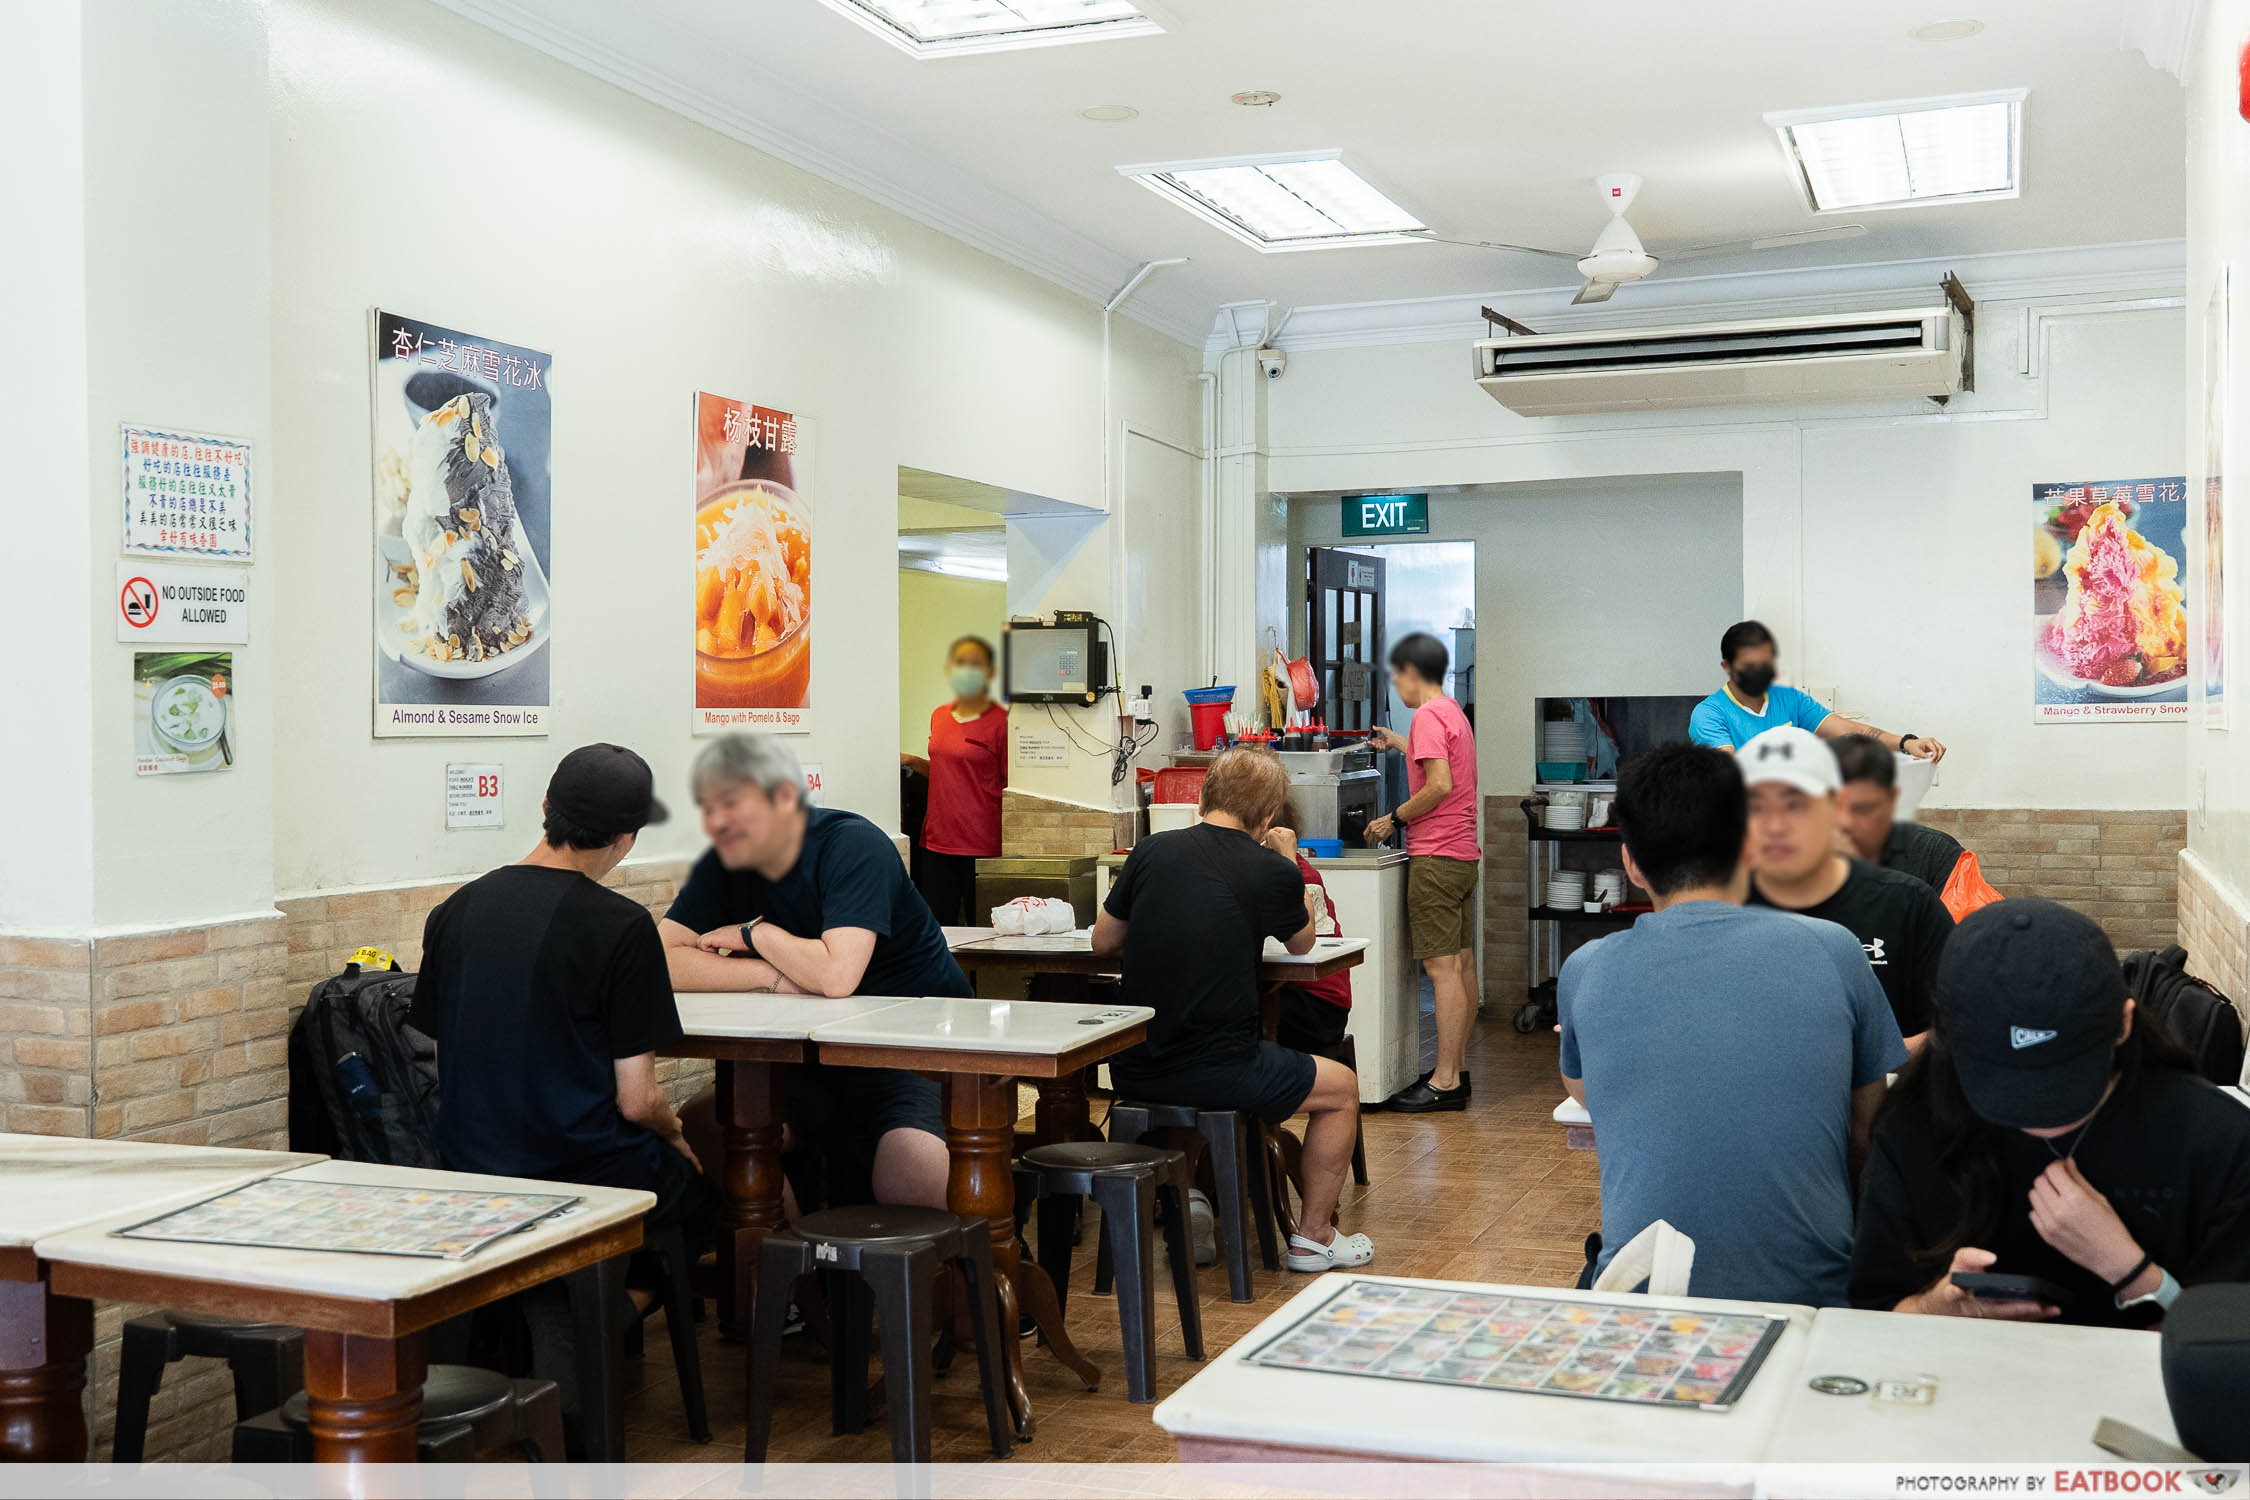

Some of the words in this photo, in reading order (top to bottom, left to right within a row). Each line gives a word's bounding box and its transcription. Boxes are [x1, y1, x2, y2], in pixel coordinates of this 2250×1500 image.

[391, 326, 543, 391] 杏仁芝麻雪花冰
[723, 406, 797, 456] 杨枝甘露
[2043, 482, 2187, 508] 芒果草莓雪花
[1362, 502, 1407, 528] EXIT
[162, 585, 176, 600] NO
[178, 586, 218, 602] OUTSIDE
[220, 588, 245, 603] FOOD
[182, 608, 227, 623] ALLOWED
[392, 709, 435, 724] Almond
[437, 710, 446, 724] &
[449, 710, 491, 724] Sesame
[493, 710, 521, 724] Snow
[523, 710, 538, 724] Ice
[704, 711, 730, 726] Mango
[731, 711, 746, 723] with
[748, 711, 774, 723] Pomelo
[776, 711, 781, 723] &
[782, 711, 800, 725] Sago
[2043, 706, 2080, 717] Mango
[2083, 705, 2091, 714] &
[2094, 704, 2157, 716] Strawberry
[478, 775, 498, 797] B3
[807, 773, 822, 791] B4
